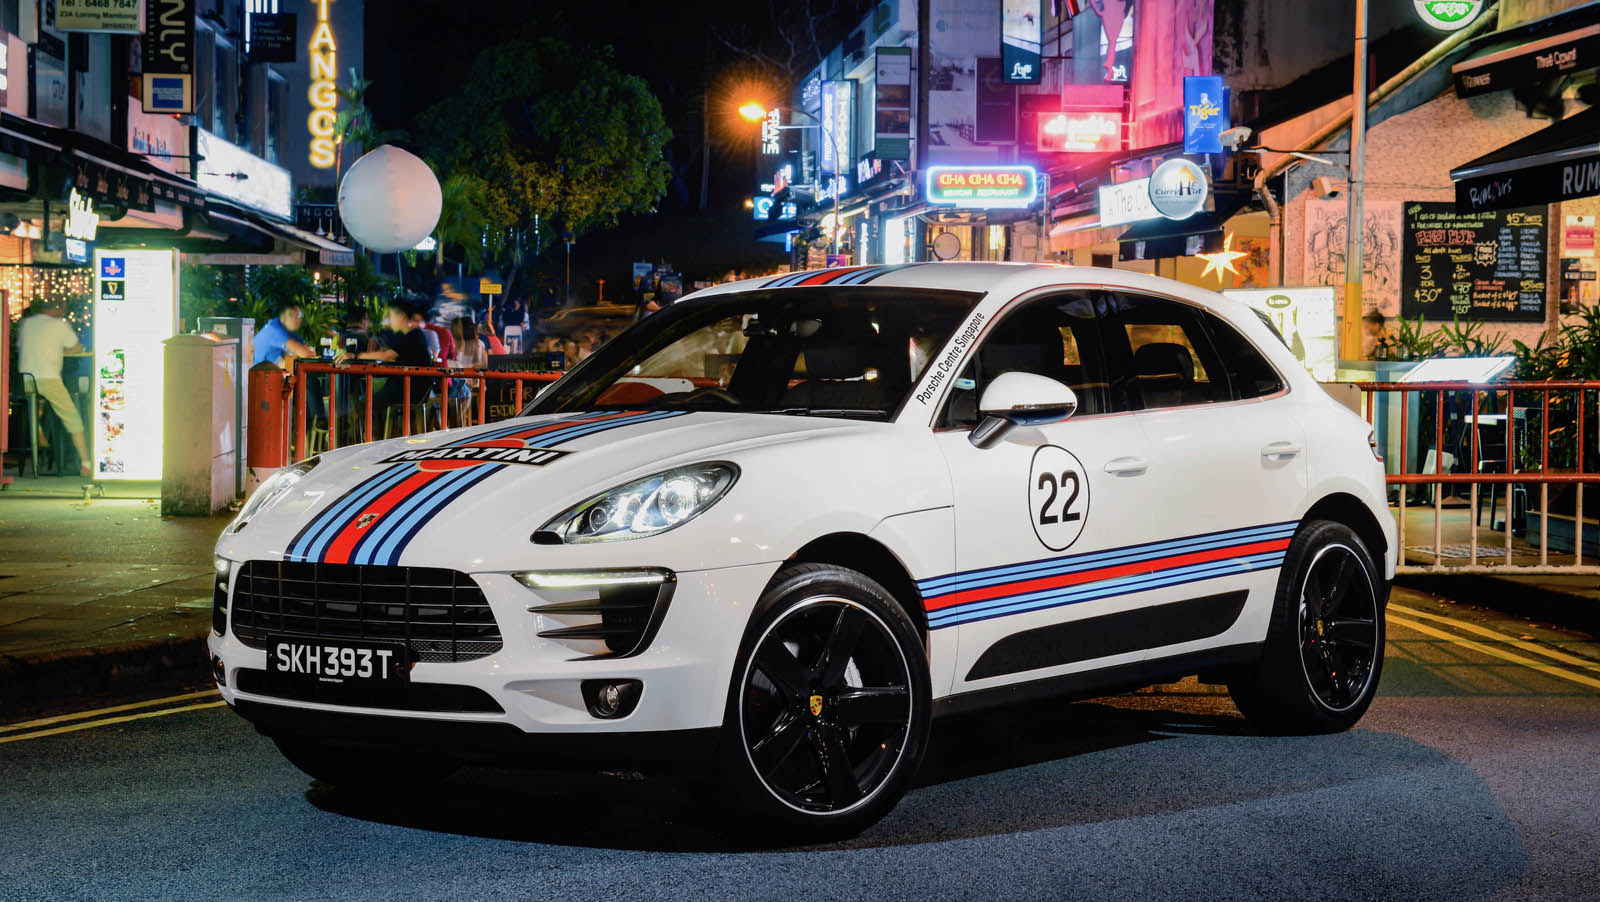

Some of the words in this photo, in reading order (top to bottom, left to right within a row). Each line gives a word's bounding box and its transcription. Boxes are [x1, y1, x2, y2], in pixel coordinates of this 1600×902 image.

[75, 11, 100, 19] Lorong
[1189, 104, 1221, 120] Tiger
[939, 173, 966, 185] CHA
[968, 173, 995, 185] CHA
[996, 173, 1023, 185] CHA
[1562, 161, 1600, 196] RUM
[1155, 188, 1178, 196] Curry
[1420, 265, 1433, 280] 3
[916, 371, 945, 405] Porsche
[938, 346, 962, 373] Centre
[954, 312, 985, 348] Singapore
[389, 447, 560, 464] MARTINI
[1038, 469, 1081, 526] 22
